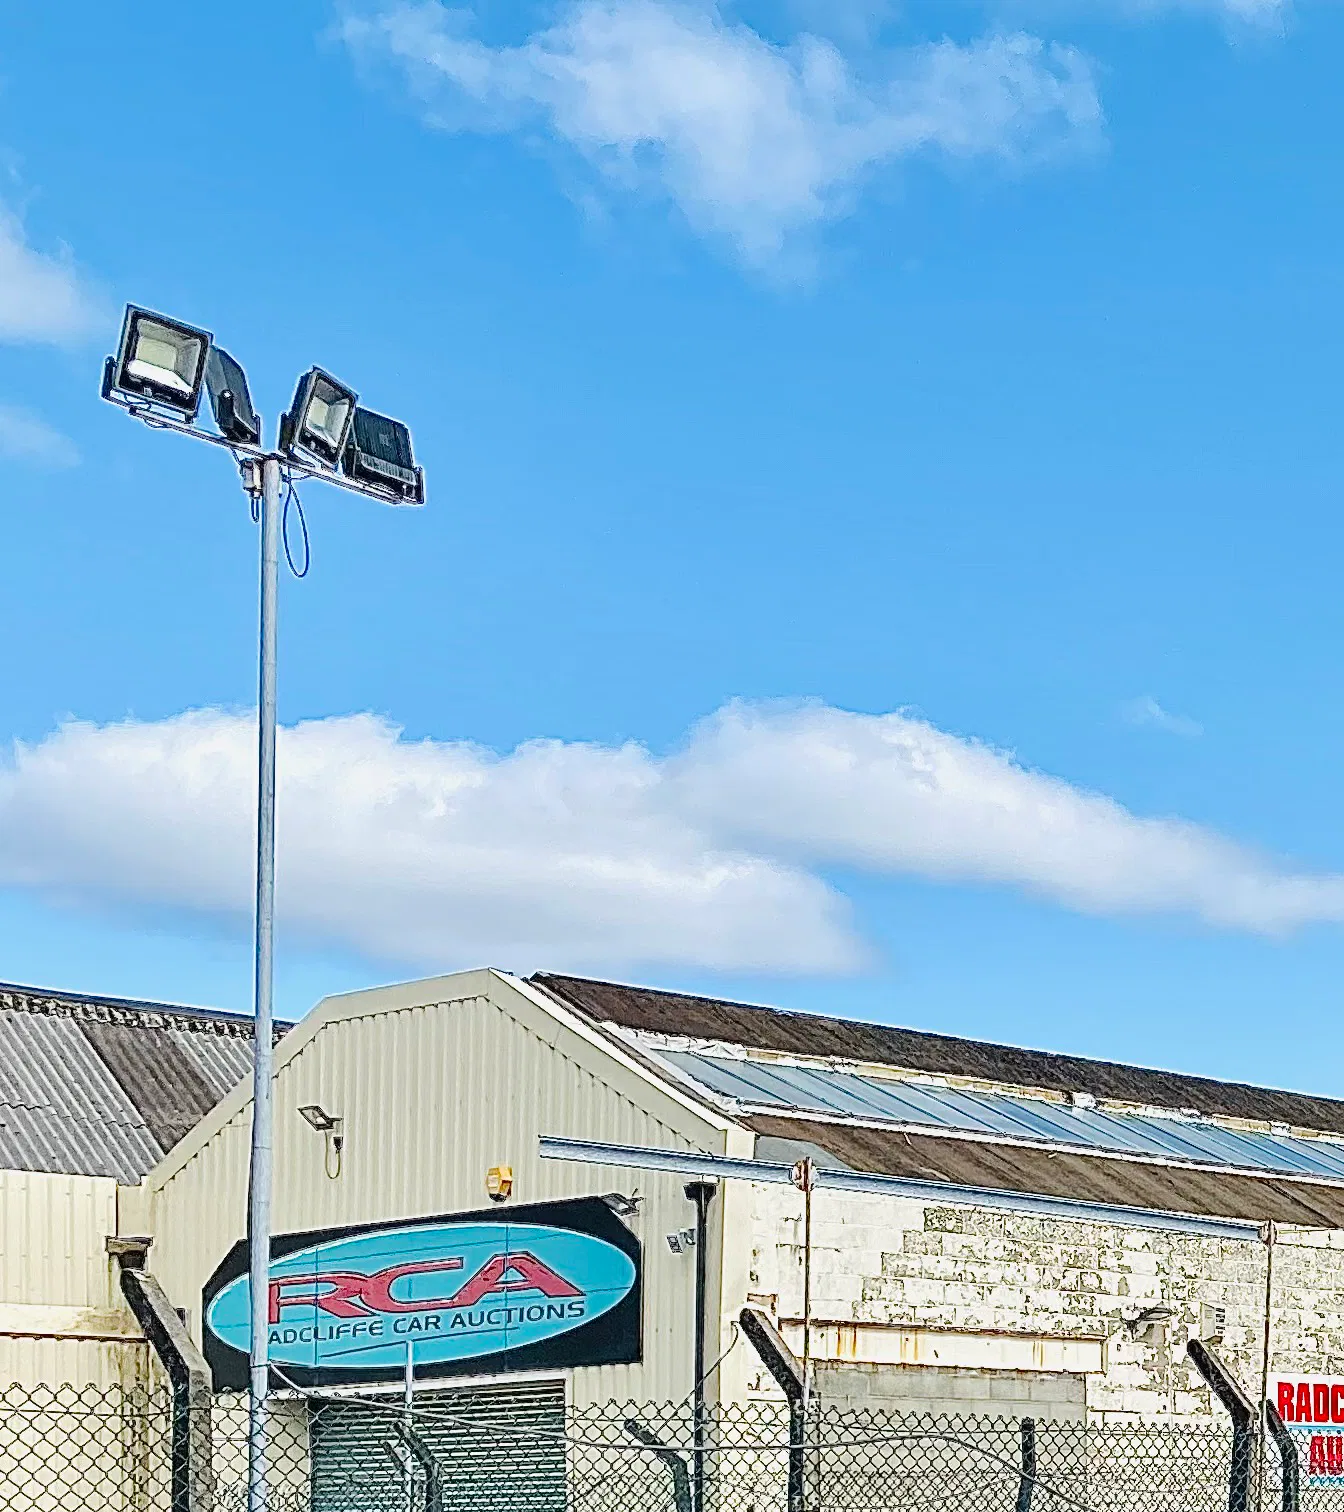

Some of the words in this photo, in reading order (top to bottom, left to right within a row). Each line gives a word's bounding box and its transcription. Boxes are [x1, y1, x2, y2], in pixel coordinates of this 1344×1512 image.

[268, 1250, 587, 1325] RCA
[268, 1319, 384, 1345] ADCLIFFE
[393, 1314, 442, 1334] CAR
[450, 1299, 586, 1329] AUCTIONS
